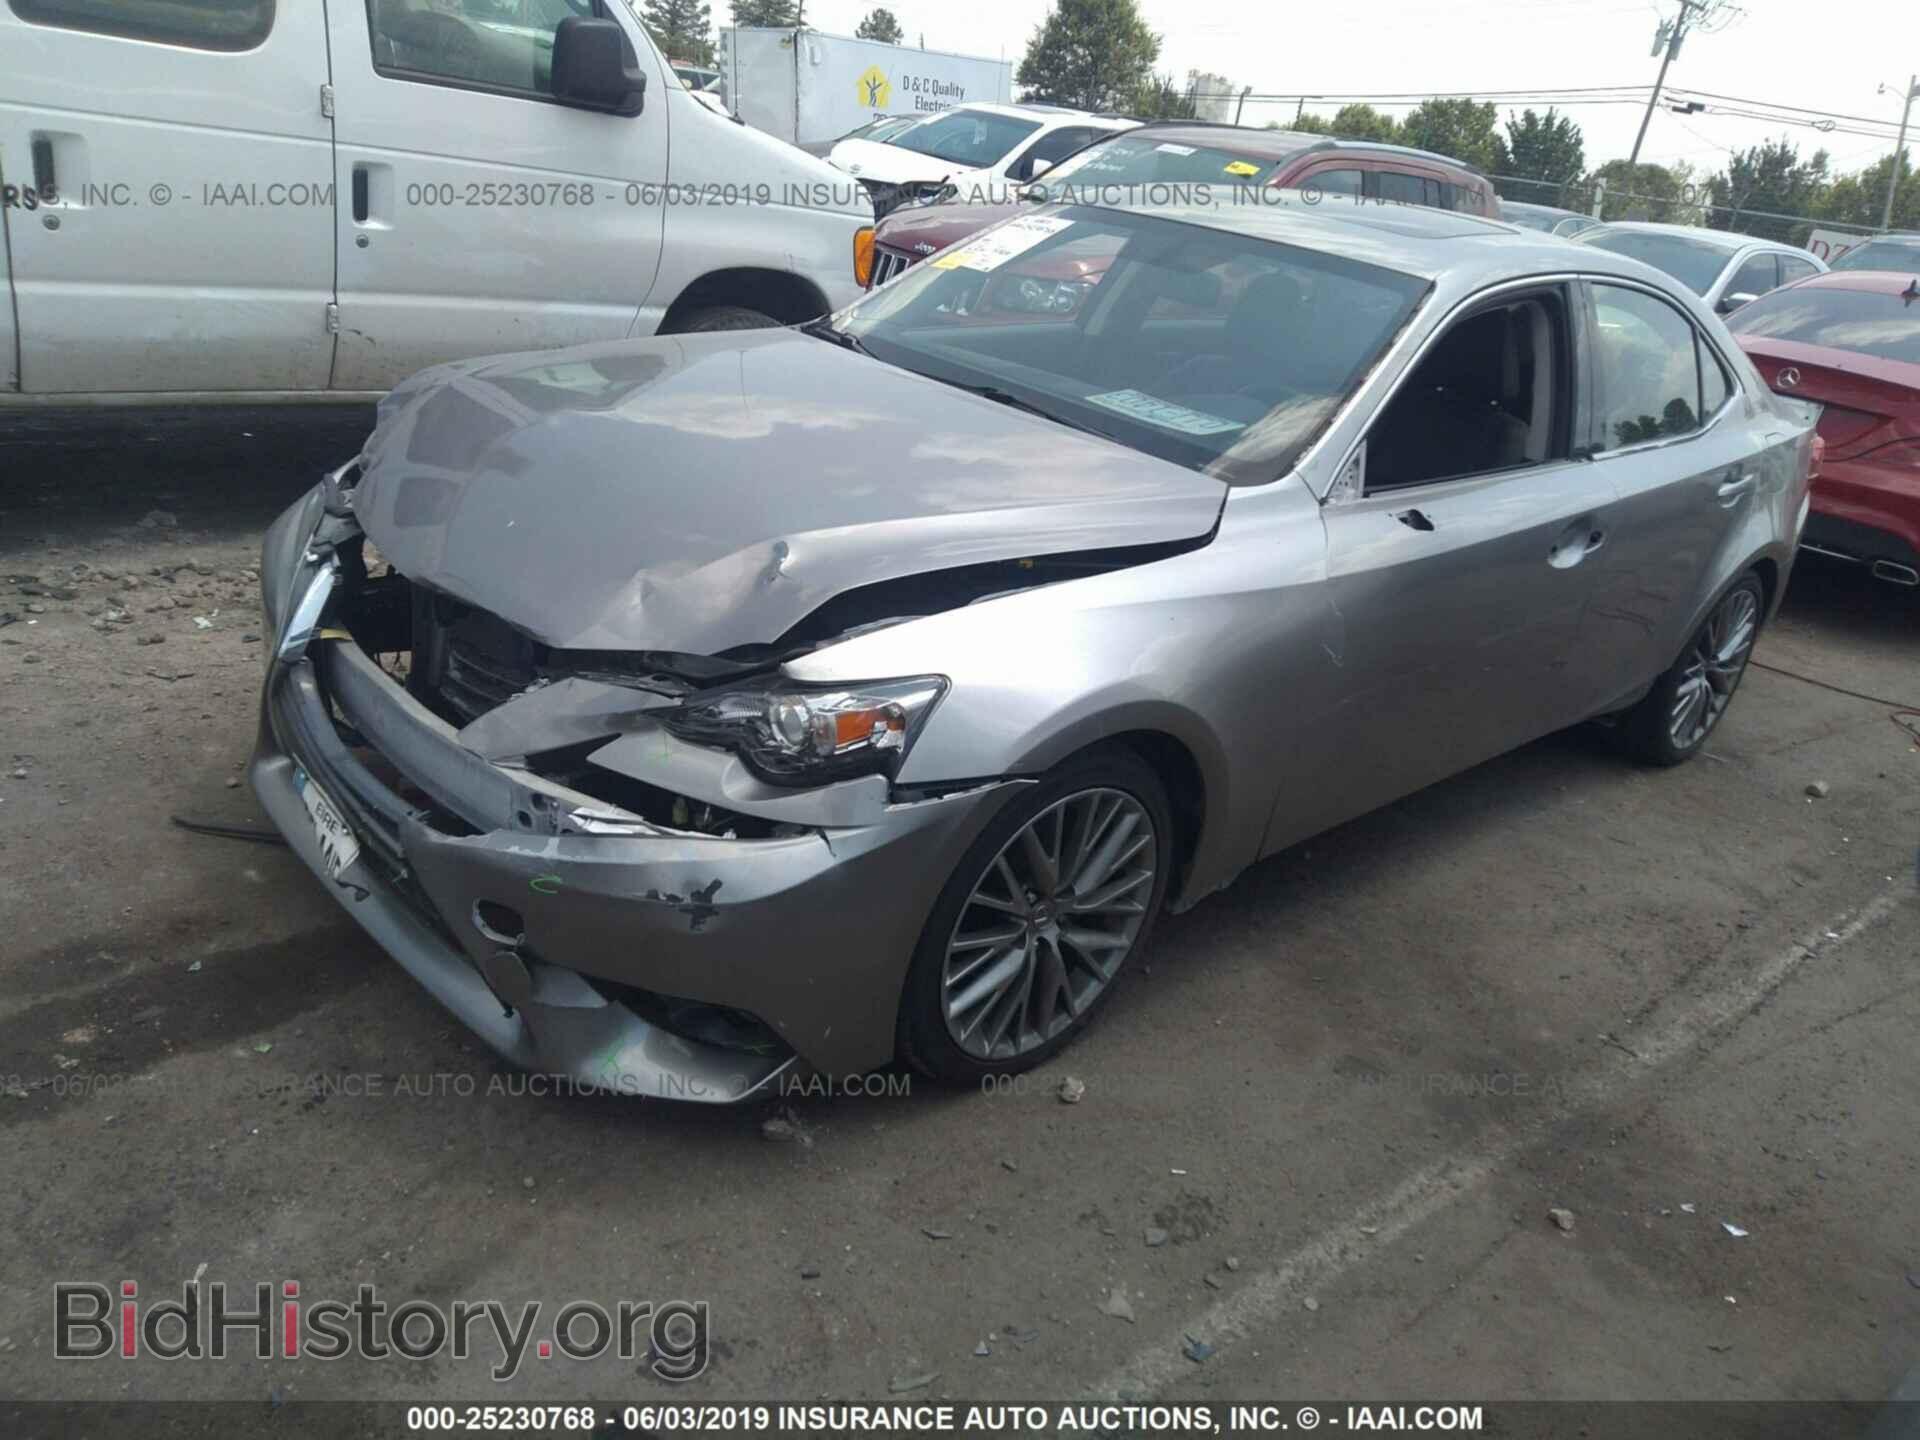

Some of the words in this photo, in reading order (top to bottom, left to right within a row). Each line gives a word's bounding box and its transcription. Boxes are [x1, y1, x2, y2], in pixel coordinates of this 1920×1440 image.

[903, 75, 910, 91] D
[911, 77, 921, 92] &
[922, 78, 930, 93] C
[932, 79, 966, 100] Quality
